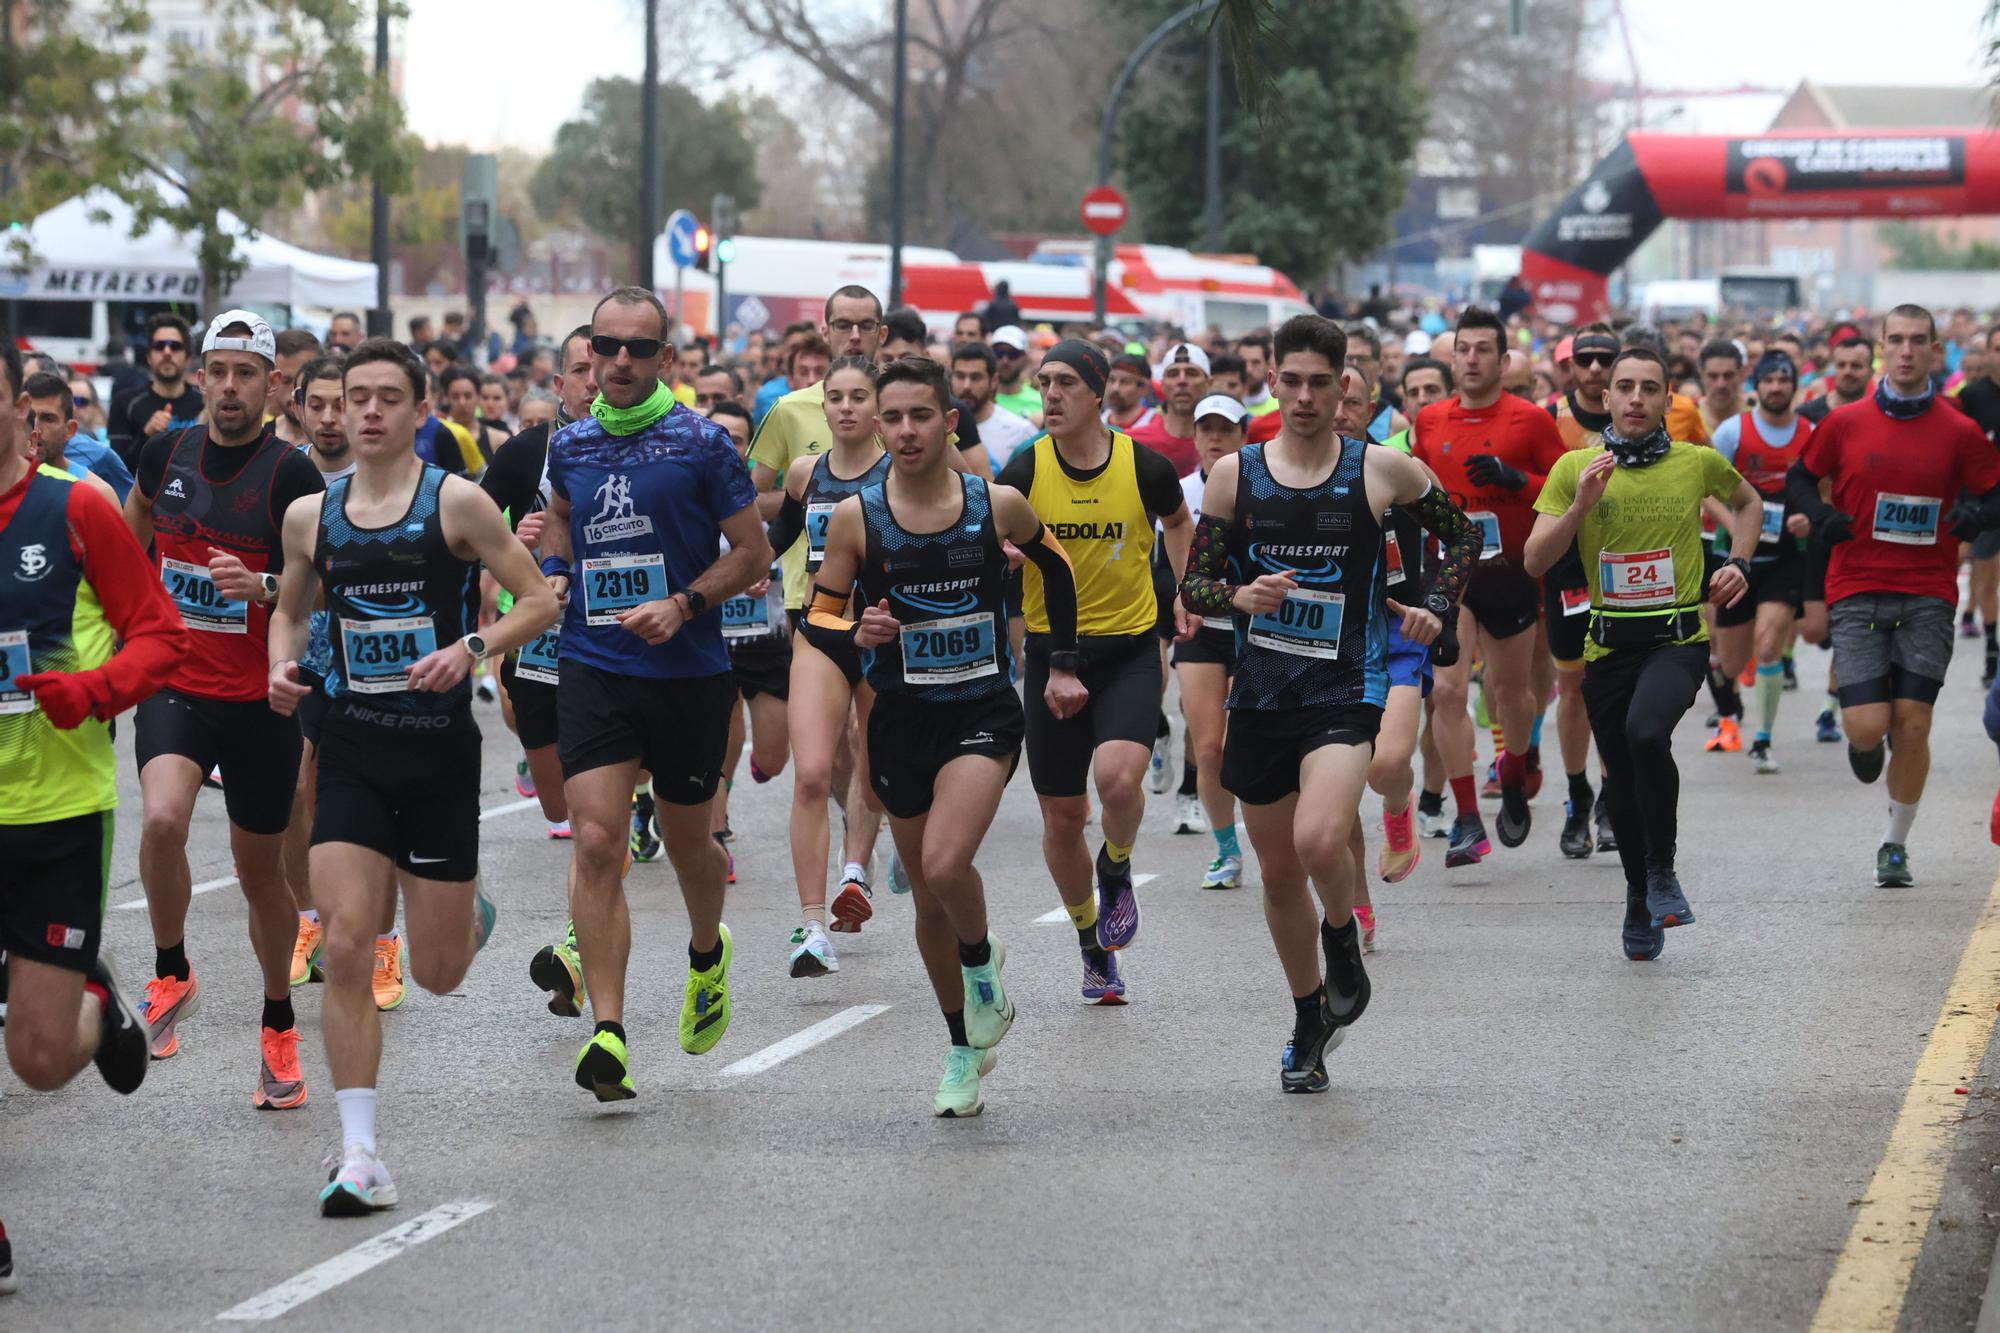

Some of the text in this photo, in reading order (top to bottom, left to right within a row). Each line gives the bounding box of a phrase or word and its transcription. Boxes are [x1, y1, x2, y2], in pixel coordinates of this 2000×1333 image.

[45, 270, 242, 296] METAESPOT
[1884, 502, 1929, 525] 2040
[588, 527, 603, 541] 16
[602, 519, 644, 534] CIRCUITO
[1260, 544, 1350, 557] METAESPORT
[594, 568, 650, 599] 2319
[902, 577, 981, 595] METAESPORT
[1626, 564, 1658, 585] 24
[344, 580, 426, 597] METAESPORT
[352, 633, 420, 665] 2334
[912, 627, 980, 658] 2069
[344, 703, 451, 729] NIKE PRO
